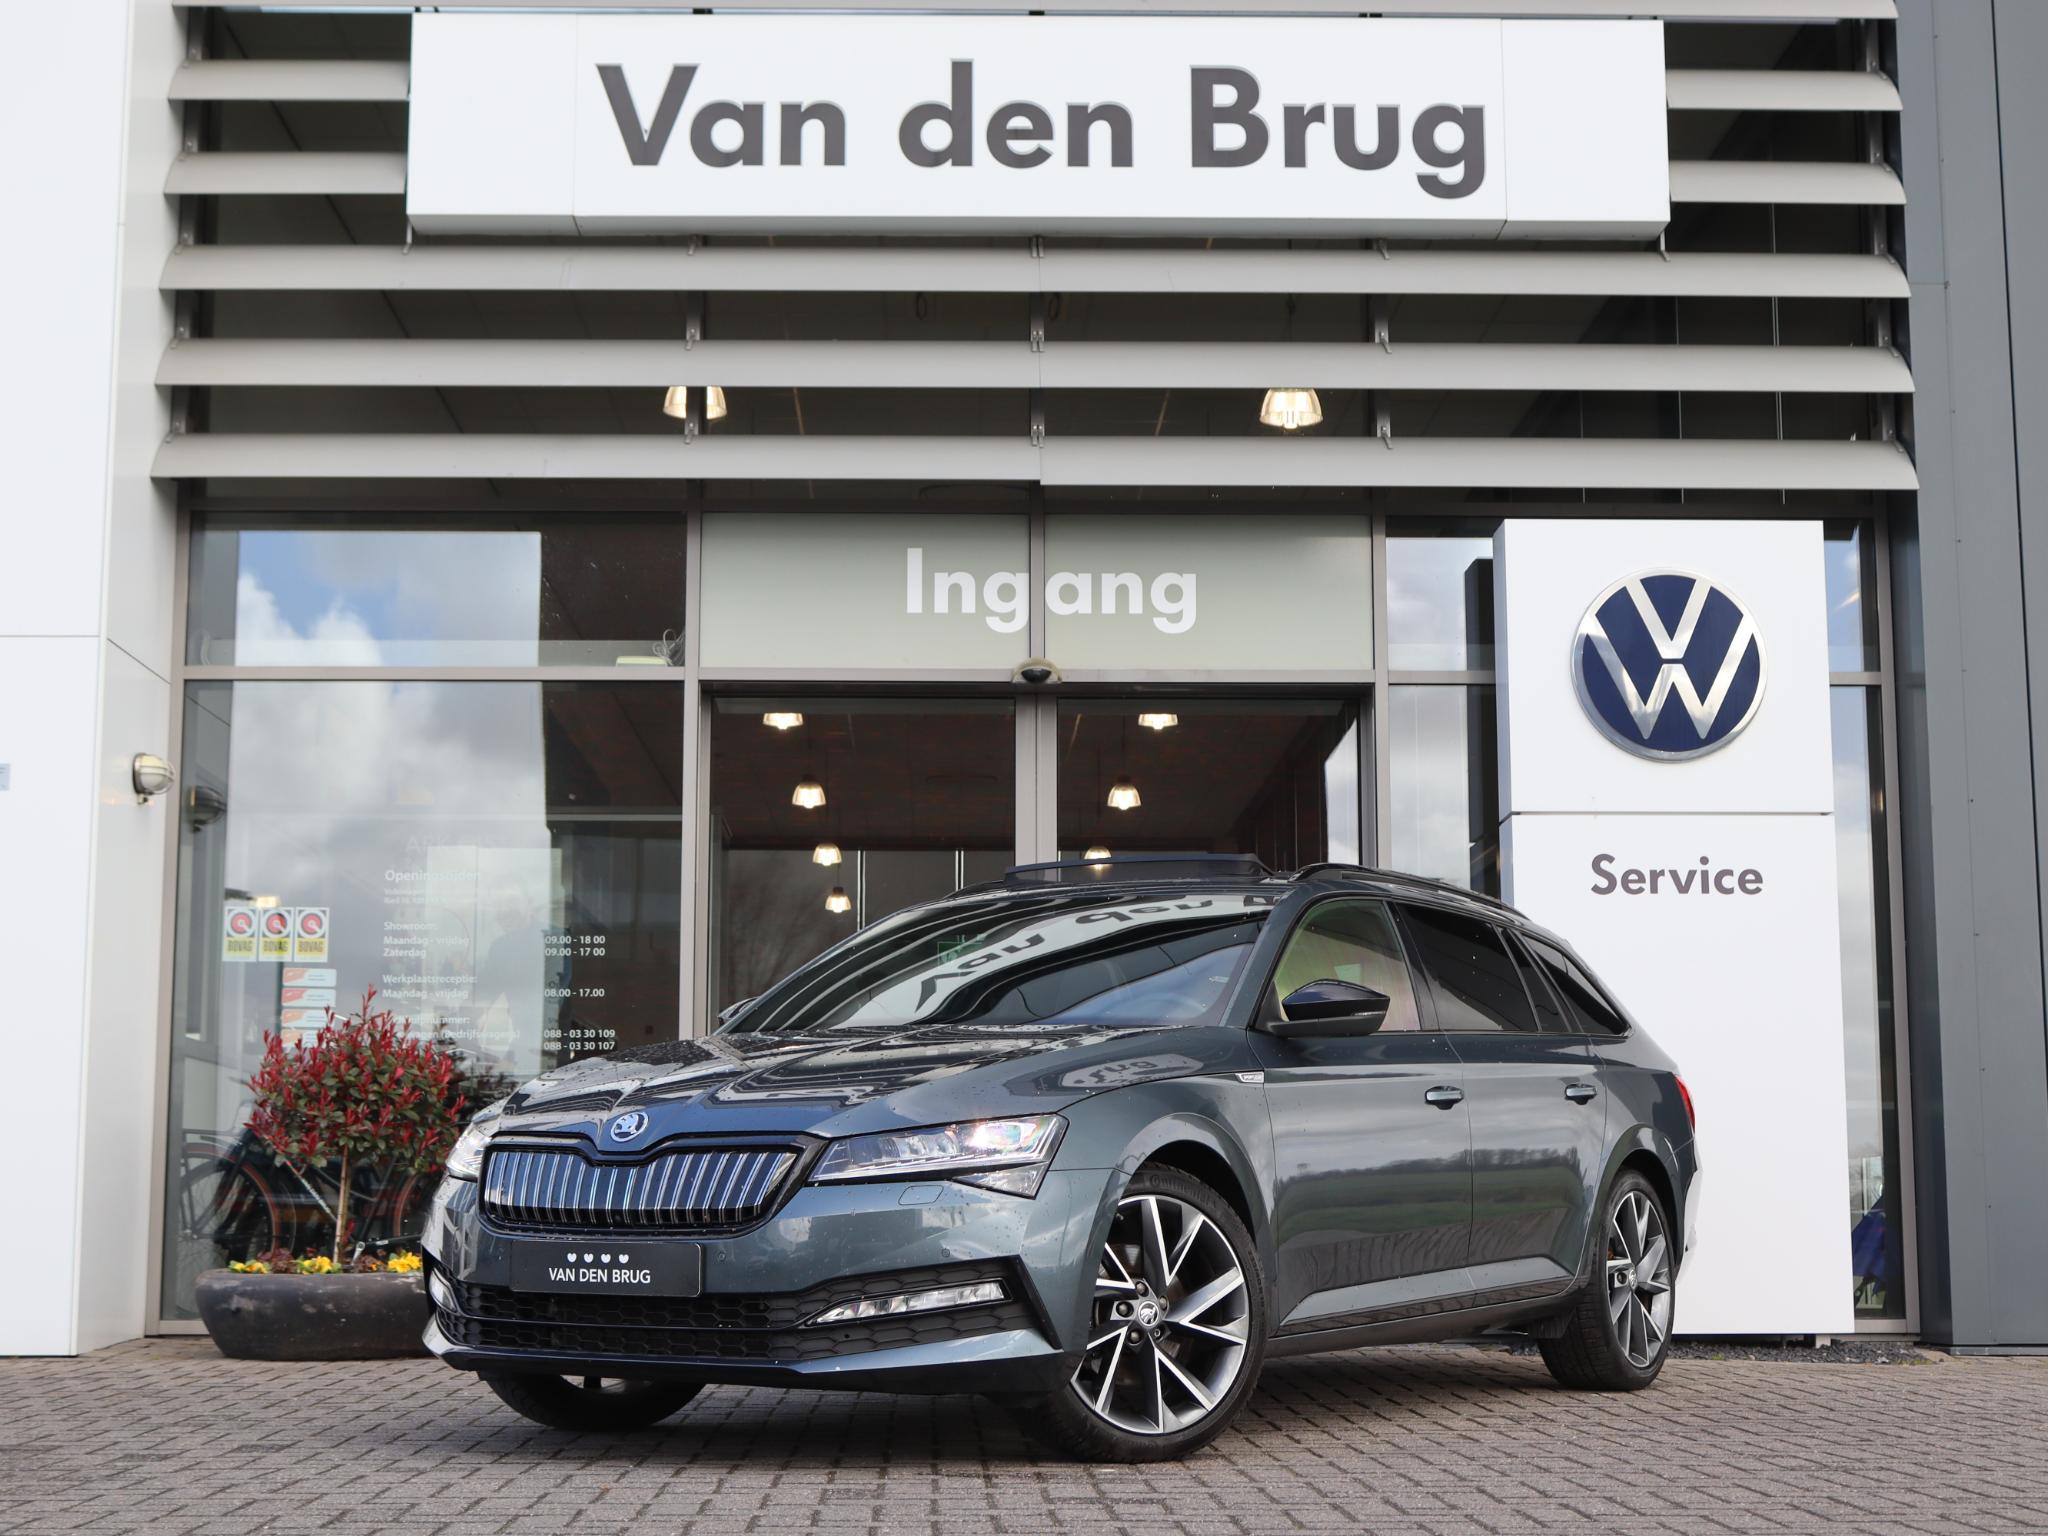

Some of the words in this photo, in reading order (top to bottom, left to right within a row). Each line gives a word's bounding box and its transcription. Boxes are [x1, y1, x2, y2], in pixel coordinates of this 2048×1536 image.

[596, 63, 847, 168] Van
[897, 58, 1135, 170] den
[1189, 65, 1487, 200] Brug
[906, 547, 1198, 634] Ingang
[1590, 853, 1764, 896] Service
[383, 936, 428, 946] Maandag
[544, 935, 572, 944] 09.00
[383, 947, 427, 958] Zaterdag
[544, 946, 572, 956] 09.00
[382, 988, 428, 999] Maandag
[435, 988, 469, 1000] vrijdag
[543, 988, 571, 998] 08.00
[579, 988, 605, 998] 17.00
[543, 1029, 562, 1038] 088
[569, 1029, 582, 1038] 03
[583, 1029, 596, 1038] 30
[598, 1029, 616, 1038] 109
[543, 1042, 562, 1051] 088
[569, 1042, 582, 1051] 03
[583, 1042, 596, 1051] 30
[598, 1042, 616, 1051] 107
[548, 1267, 576, 1282] VAN
[579, 1268, 608, 1283] DEN
[612, 1269, 651, 1284] BRUG
